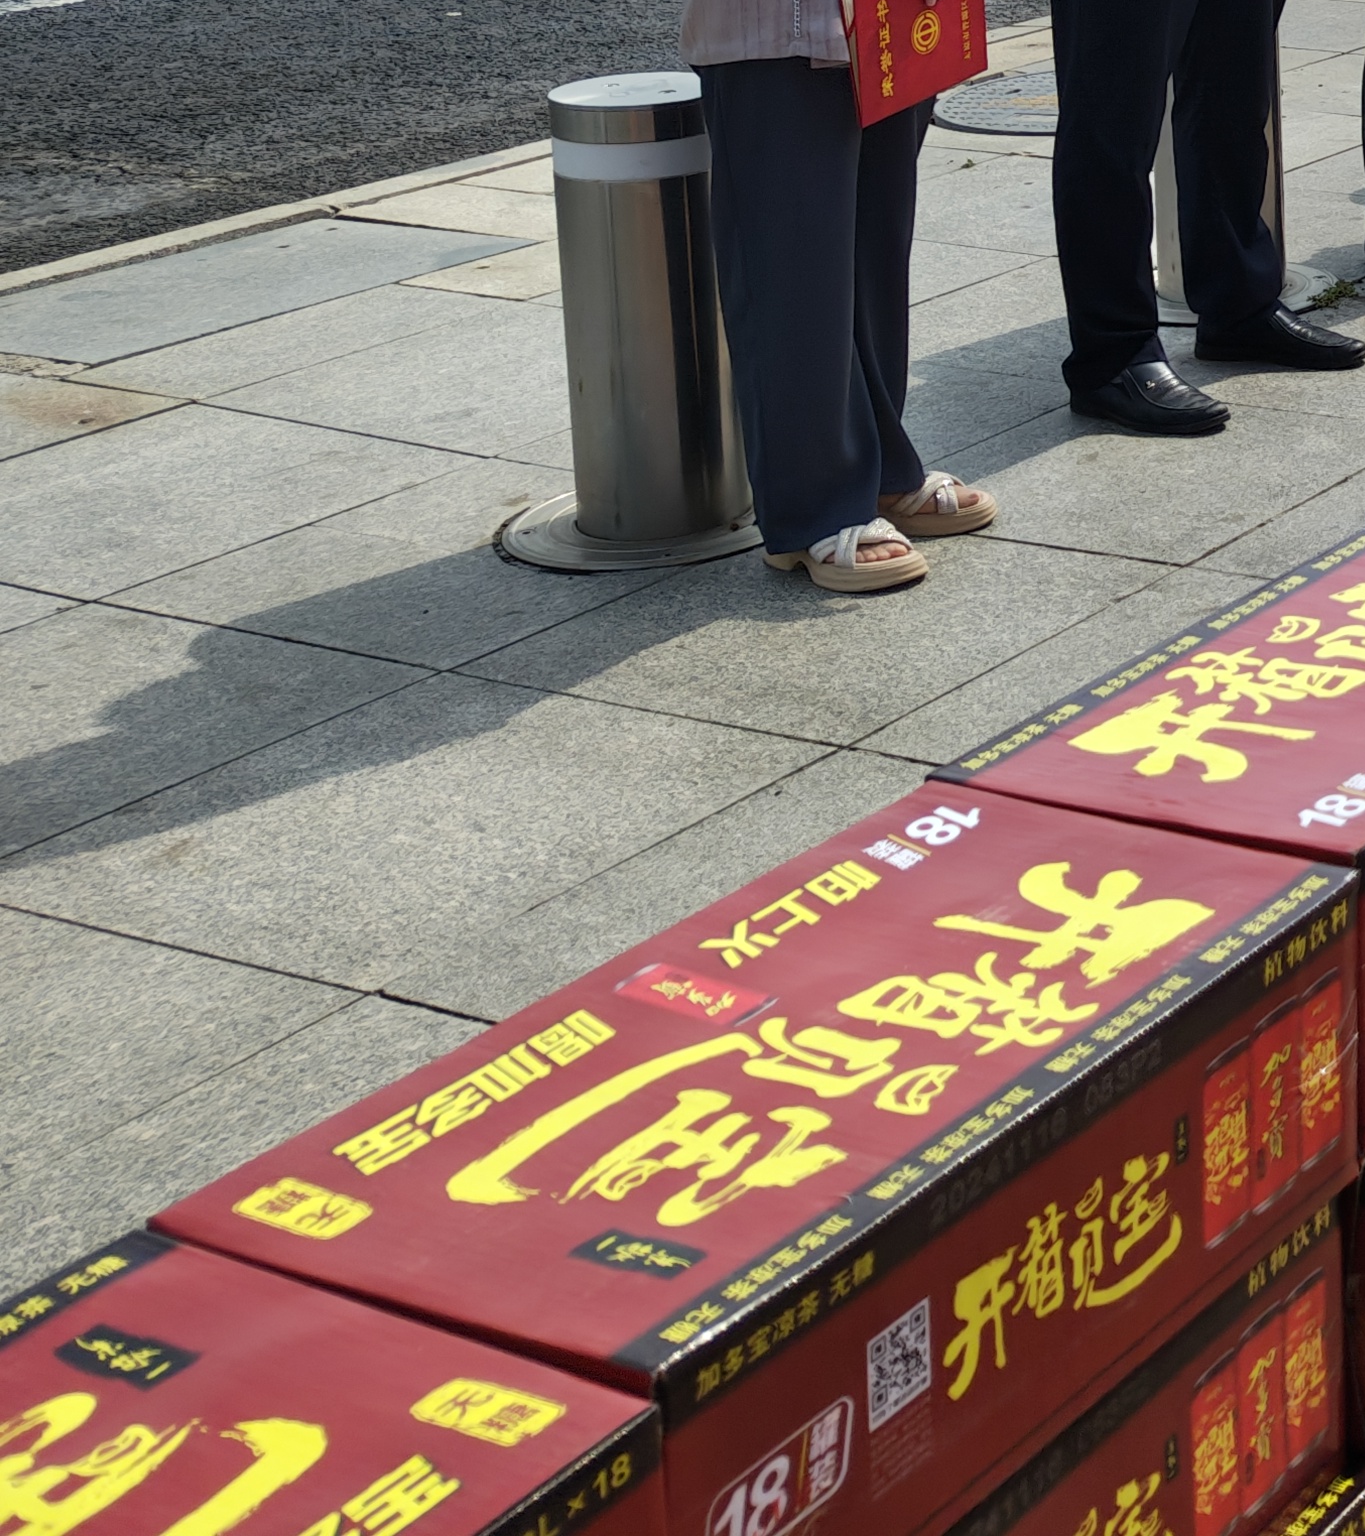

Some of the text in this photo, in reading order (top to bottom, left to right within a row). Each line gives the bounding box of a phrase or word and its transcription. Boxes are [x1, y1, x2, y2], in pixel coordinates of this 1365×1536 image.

[902, 800, 982, 847] 18
[699, 860, 881, 969] 怕上火
[1264, 899, 1348, 987] 植物饮料
[332, 1009, 619, 1181] 喝加多宝
[443, 860, 1217, 1231] 开箱见宝
[721, 1216, 853, 1301] 加多宝凉茶
[940, 1149, 1184, 1401] 开箱见宝
[1249, 1203, 1331, 1298] 植物饮料
[659, 1302, 725, 1344] 无糖
[697, 1251, 874, 1401] 加多宝凉茶 无糖
